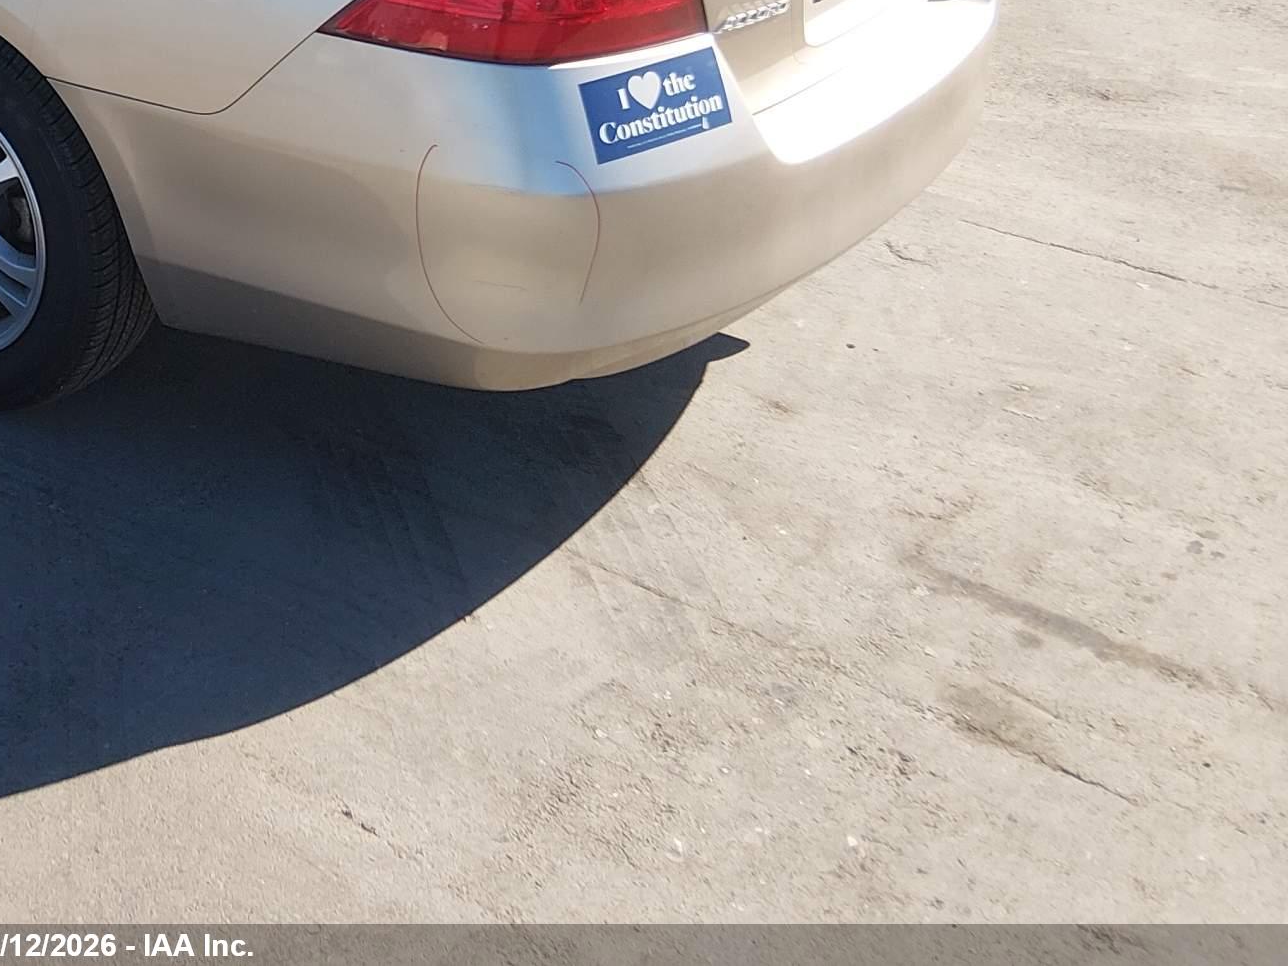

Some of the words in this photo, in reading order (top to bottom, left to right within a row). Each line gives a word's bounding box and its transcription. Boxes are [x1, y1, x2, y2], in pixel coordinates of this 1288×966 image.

[616, 87, 630, 110] I
[662, 72, 697, 96] the
[598, 94, 724, 145] Constitution
